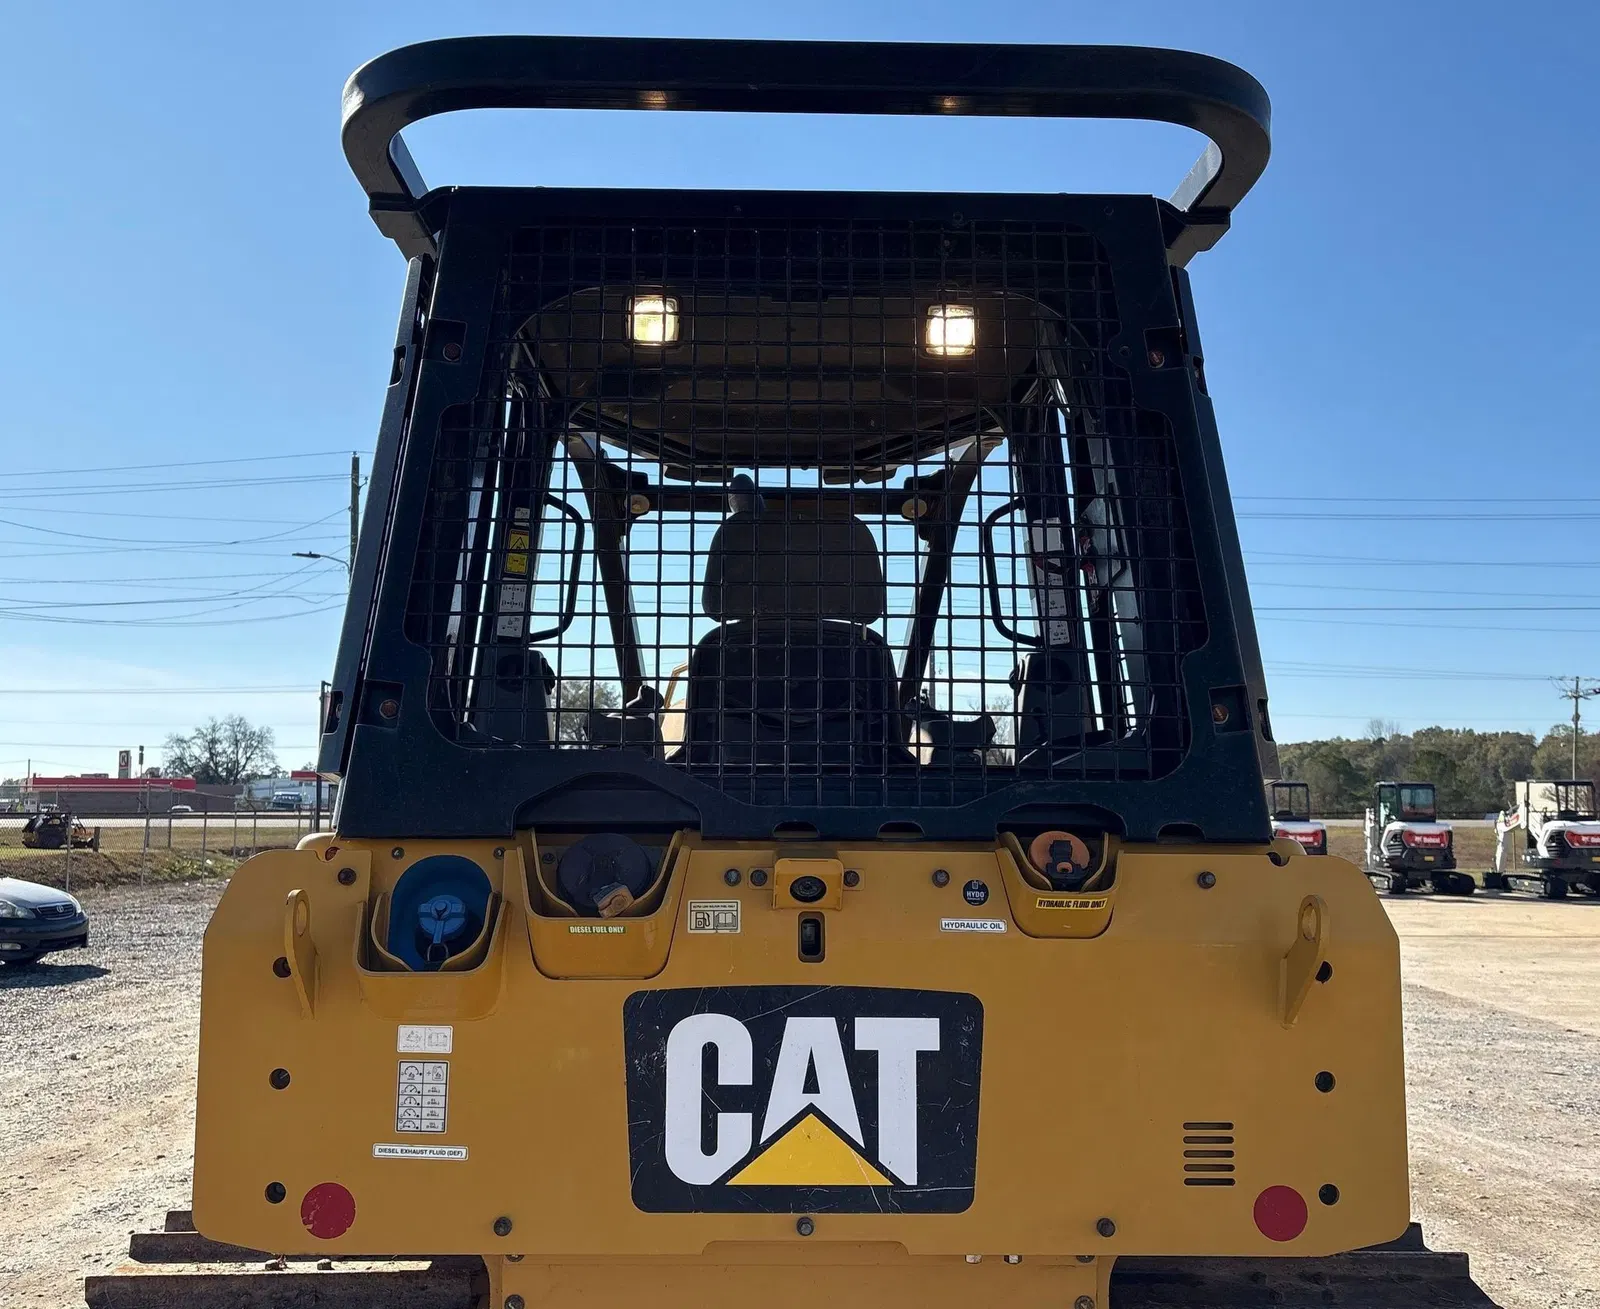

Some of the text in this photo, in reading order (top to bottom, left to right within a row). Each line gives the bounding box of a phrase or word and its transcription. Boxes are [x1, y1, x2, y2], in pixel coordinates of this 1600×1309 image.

[1038, 900, 1072, 908] HYDRAULIC
[1072, 900, 1090, 908] FLUID
[665, 1013, 940, 1185] CAT
